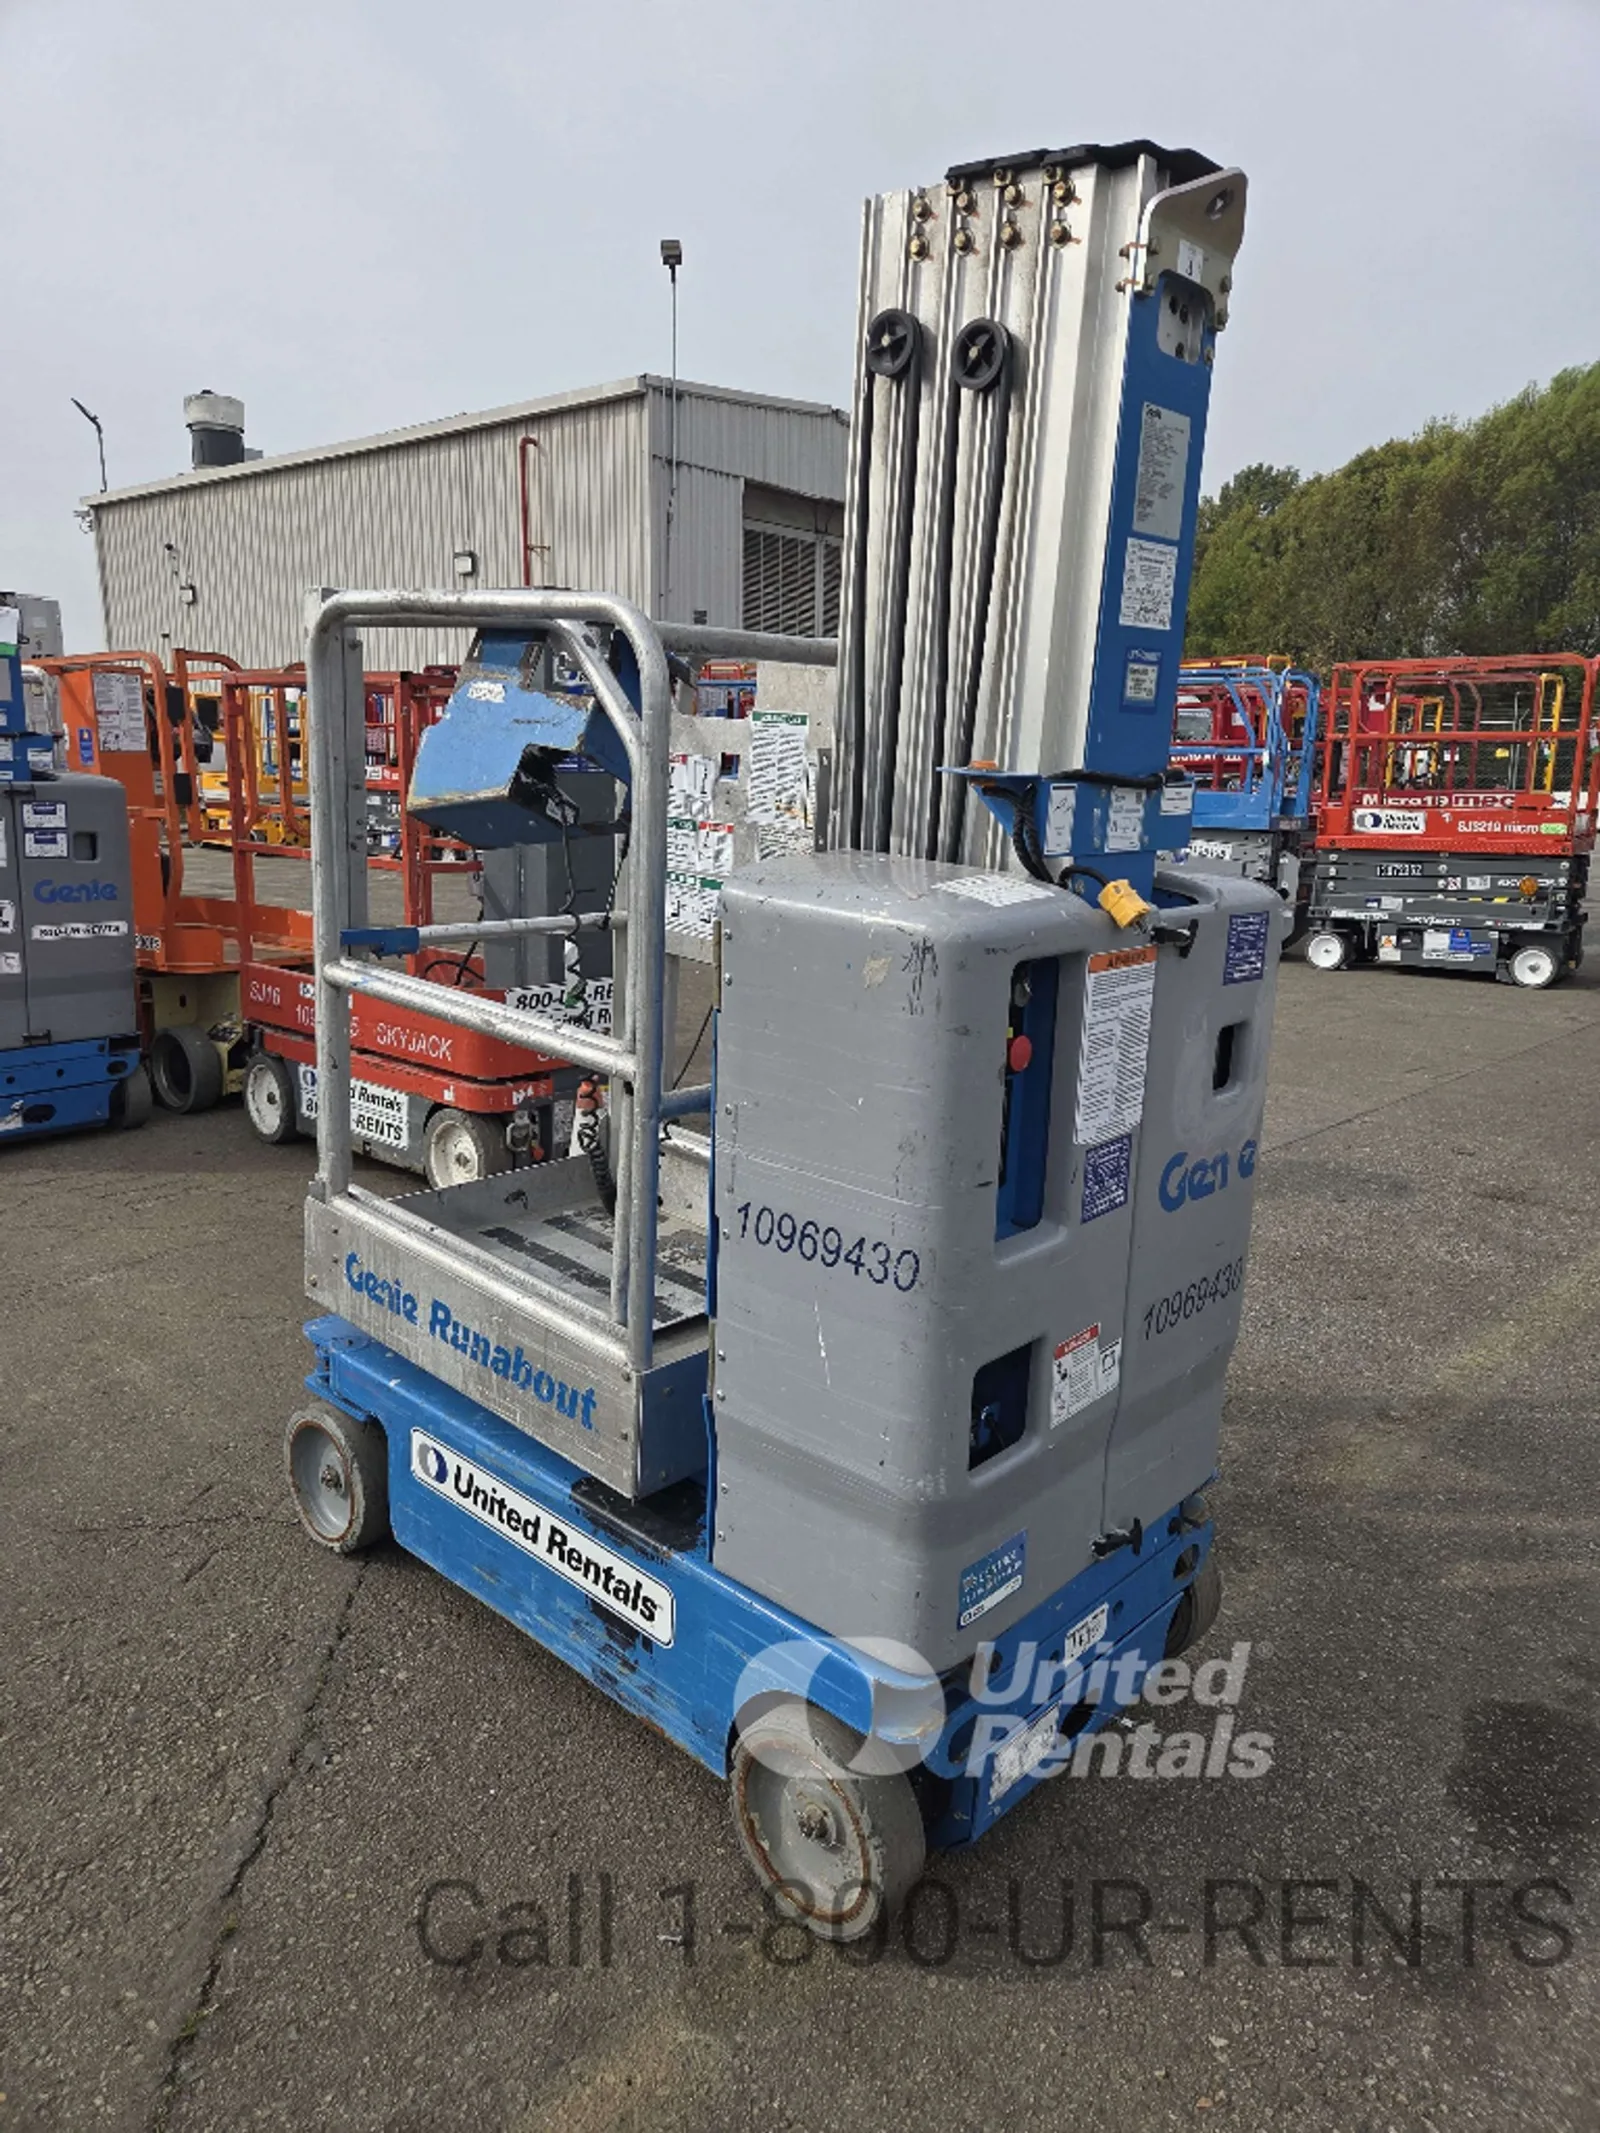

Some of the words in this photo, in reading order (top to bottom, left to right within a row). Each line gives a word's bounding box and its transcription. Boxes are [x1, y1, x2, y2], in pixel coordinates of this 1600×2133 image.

[33, 879, 118, 904] Genie
[250, 981, 281, 1005] SJ16
[376, 1022, 453, 1062] SKYJACK
[738, 1202, 920, 1292] 10969430
[345, 1251, 419, 1326] Genie
[429, 1299, 598, 1431] Runabout
[1144, 1256, 1243, 1341] 10969430
[453, 1464, 541, 1544] United
[546, 1525, 659, 1623] Rentals
